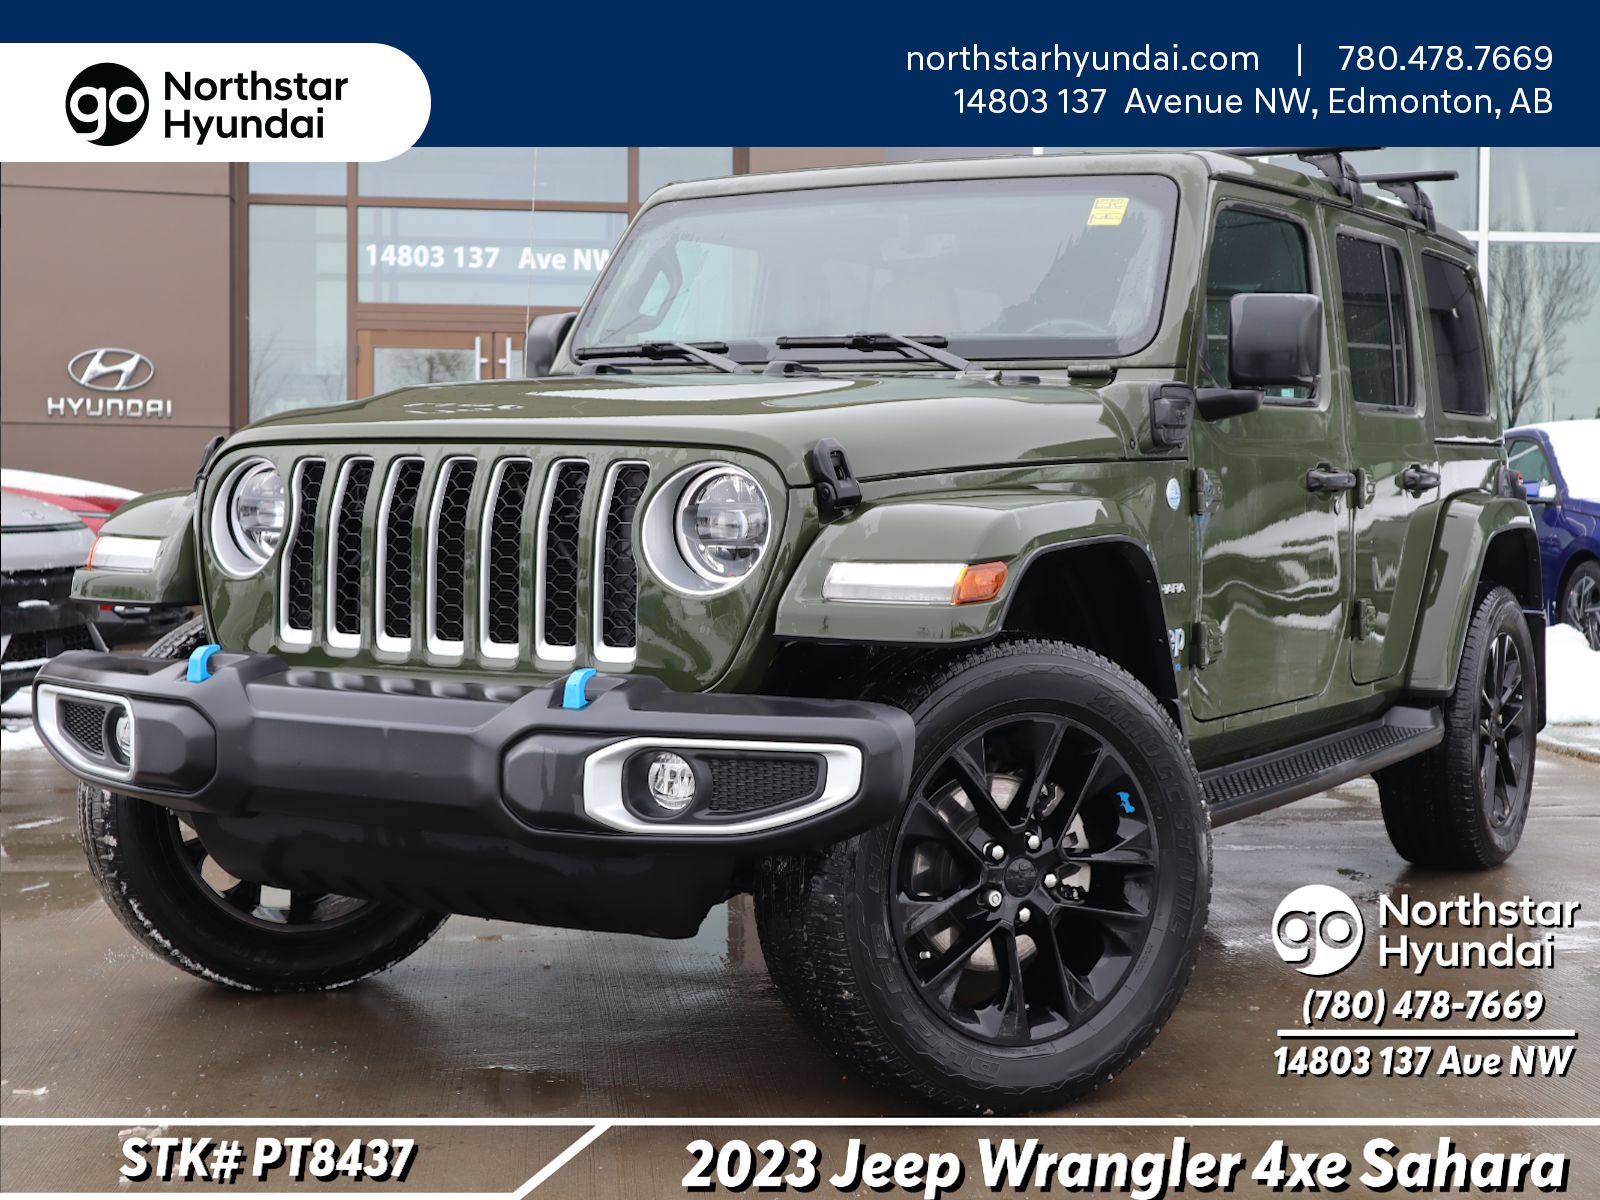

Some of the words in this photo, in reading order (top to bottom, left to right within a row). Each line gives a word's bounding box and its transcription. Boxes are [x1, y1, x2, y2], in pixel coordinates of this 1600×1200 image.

[365, 243, 445, 269] 14803
[453, 245, 501, 269] 137
[518, 246, 567, 270] Ave
[47, 396, 173, 418] HYUNDAI
